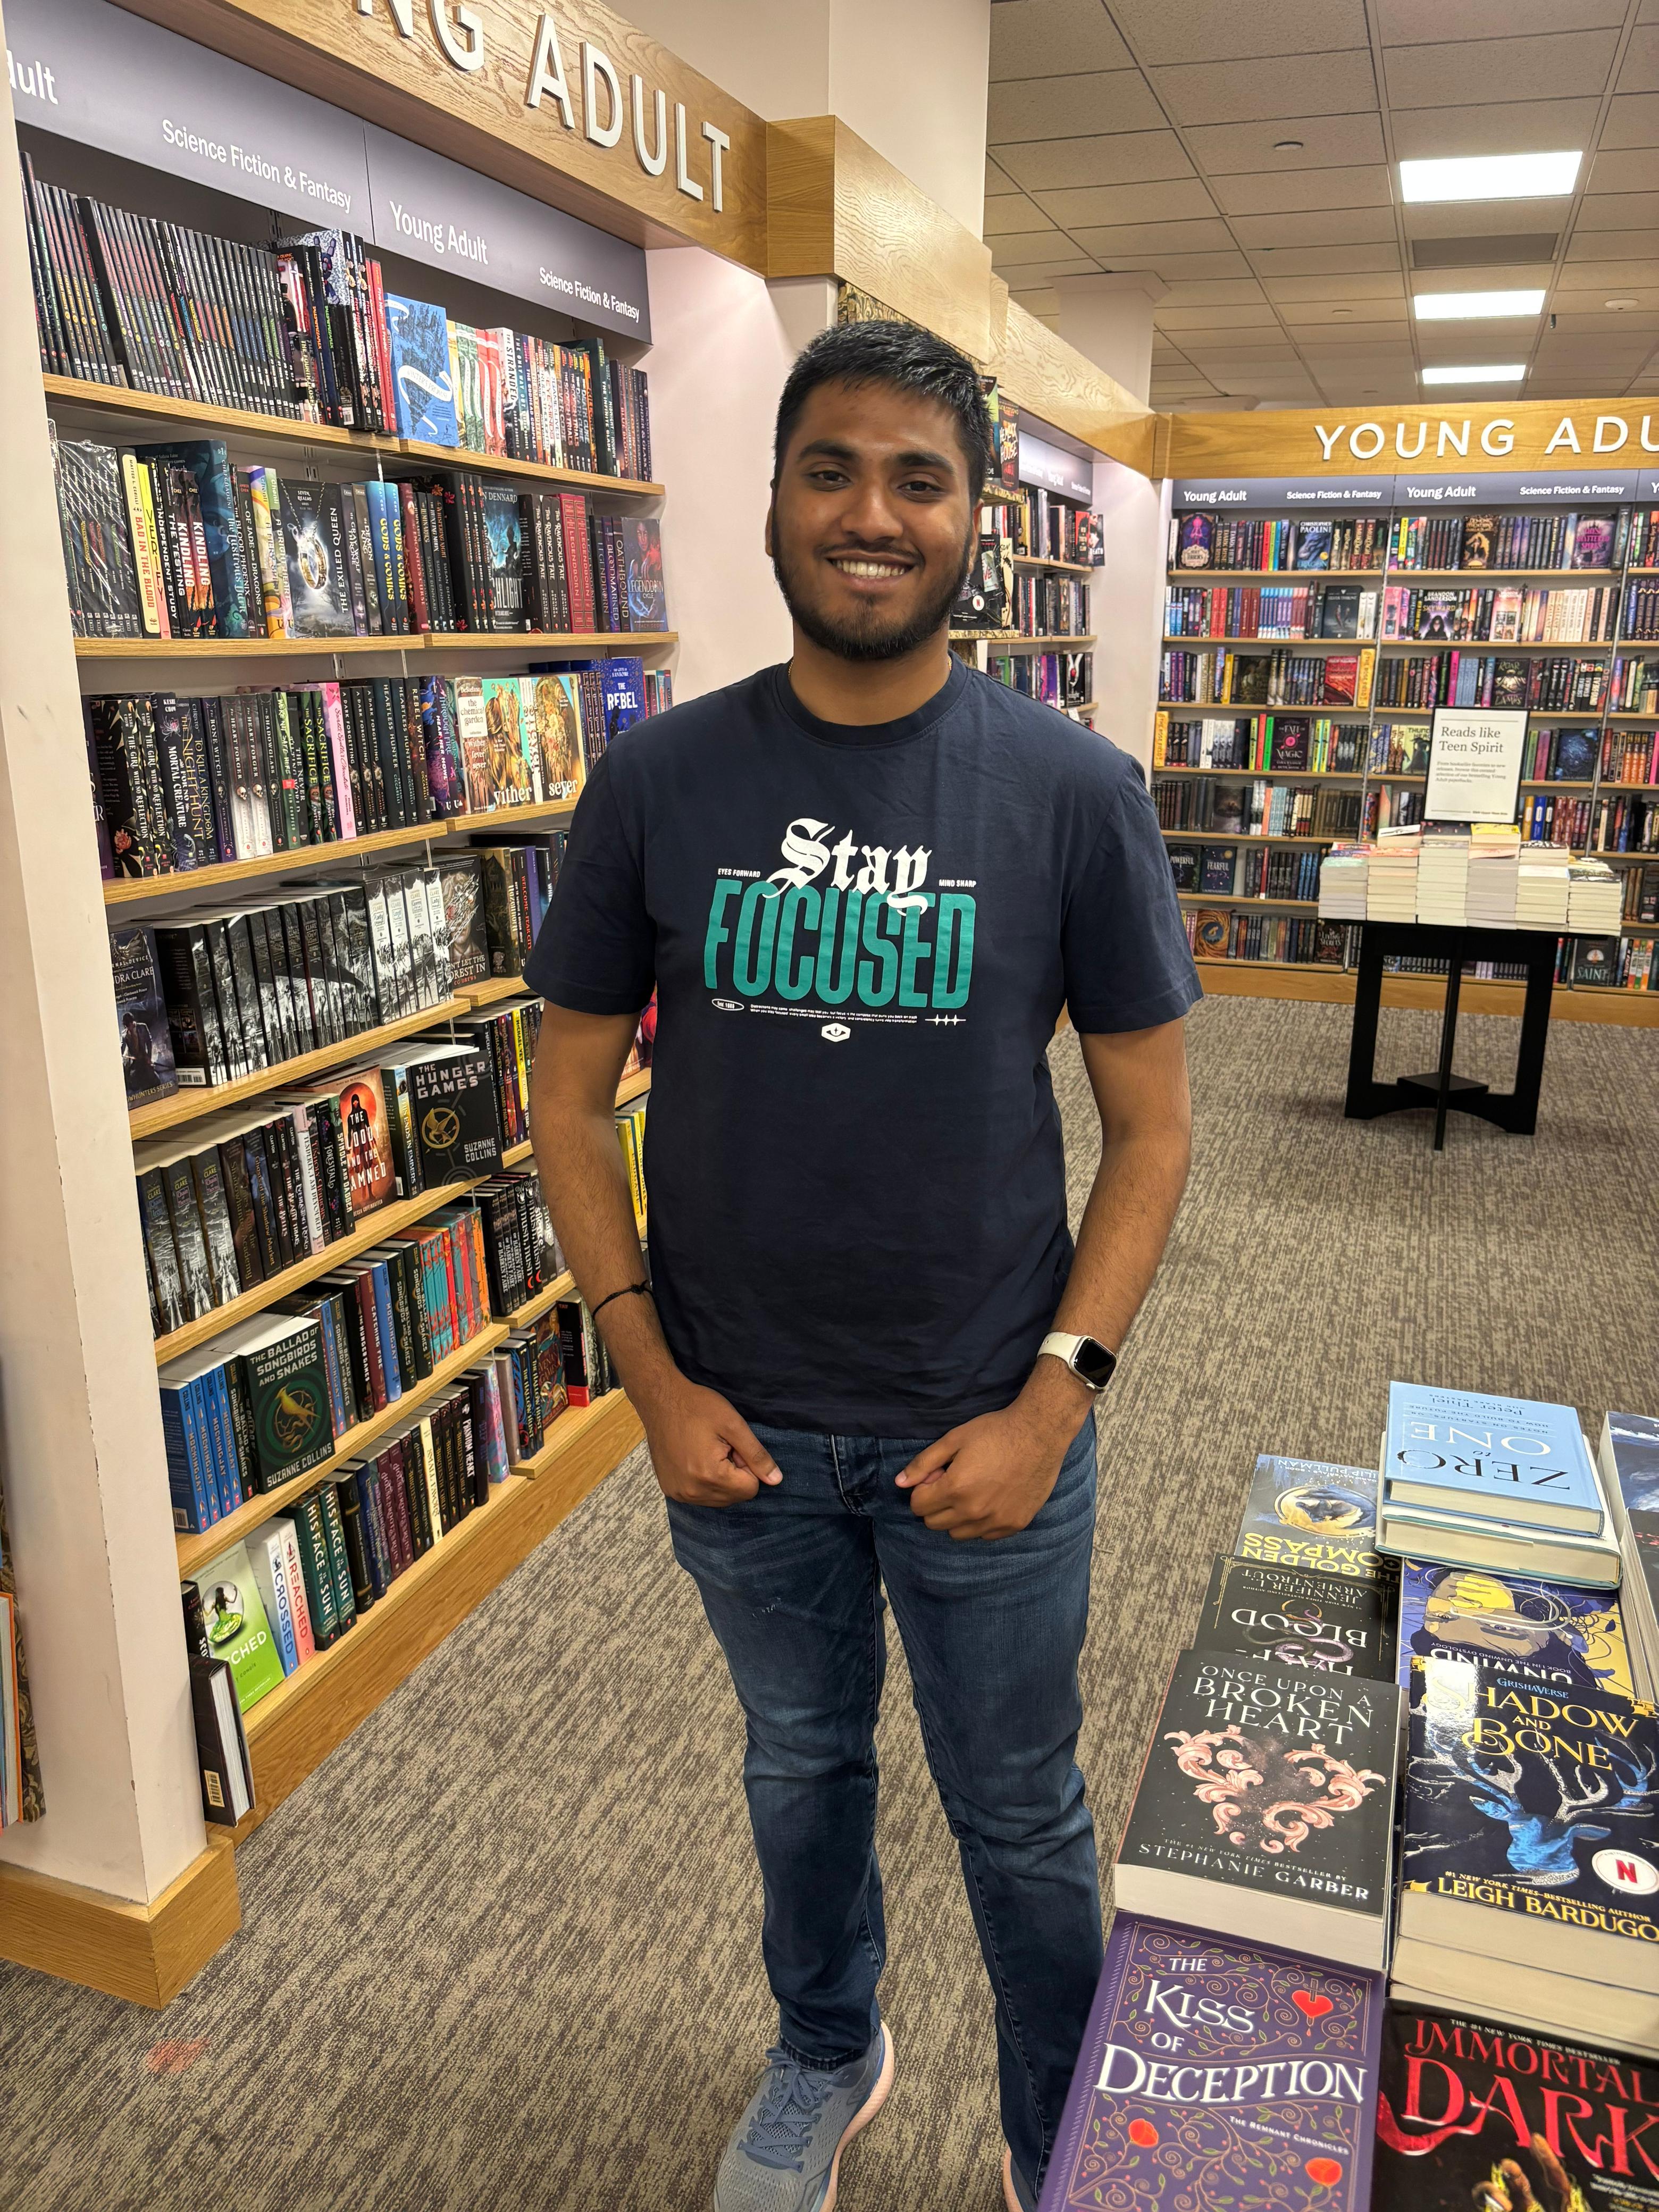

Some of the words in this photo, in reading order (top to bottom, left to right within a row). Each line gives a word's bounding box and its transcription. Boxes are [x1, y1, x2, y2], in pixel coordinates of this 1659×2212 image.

[525, 14, 731, 213] ADULT
[162, 118, 227, 163] Science
[230, 145, 280, 184] Fiction
[284, 166, 297, 190] &
[299, 171, 352, 214] Fantasy
[389, 200, 445, 254] Young
[448, 225, 489, 266] Adult
[539, 266, 574, 297] Science
[575, 280, 602, 307] Fiction
[603, 292, 610, 308] &
[611, 295, 640, 323] Fantasy
[506, 341, 516, 400] STRANDED
[1314, 418, 1515, 460] YOUNG
[489, 493, 518, 504] DENNARD
[1184, 491, 1217, 503] Young
[1219, 490, 1247, 501] Adult
[1286, 491, 1314, 500] Science
[1317, 490, 1342, 499] Fiction
[1344, 490, 1351, 499] &
[1351, 489, 1382, 500] Fantasy
[1406, 487, 1442, 500] Young
[1444, 486, 1476, 498] Adult
[1519, 486, 1552, 496] Science
[1553, 486, 1581, 495] Fiction
[1582, 486, 1590, 495] &
[1591, 484, 1625, 495] Fantasy
[135, 516, 145, 538] BAD
[330, 507, 341, 546] QUEEN
[141, 555, 150, 575] THE
[146, 509, 164, 602] VERIFY
[167, 513, 177, 539] THE
[173, 542, 185, 597] TESTING
[177, 522, 195, 587] KINDLING
[193, 521, 211, 586] KINDLING
[336, 549, 345, 588] EXILED
[144, 577, 155, 608] BLOOD
[616, 540, 629, 618] OATHBOUND
[167, 585, 177, 619] STUDY
[460, 707, 485, 716] chemical
[607, 692, 638, 711] REBEL
[383, 684, 393, 731] HEARTLESS
[390, 734, 398, 768] HUNTER
[412, 689, 421, 720] REBEL
[417, 725, 425, 761] WITCH
[464, 715, 484, 725] garden
[1440, 726, 1476, 738] Reads
[1479, 727, 1501, 739] like
[305, 719, 317, 784] SACRIFICE
[1439, 741, 1468, 751] Teen
[1471, 742, 1504, 755] Spirit
[549, 778, 578, 796] sever
[718, 868, 732, 876] EYES
[733, 869, 761, 878] FORWARD
[762, 818, 932, 917] Stay
[1207, 860, 1229, 871] FEARFUL
[939, 879, 956, 887] MIND
[957, 879, 977, 888] SHARP
[704, 878, 977, 1009] FOCUSED
[1577, 967, 1607, 981] SAINT
[415, 1060, 486, 1087] HUNGER
[418, 1063, 436, 1073] THE
[417, 1075, 480, 1100] GAMES
[350, 1111, 364, 1126] THE
[346, 1123, 380, 1151] LOODY
[464, 1137, 495, 1153] SUZANNE
[364, 1150, 378, 1162] THE
[465, 1147, 497, 1163] COLLINS
[337, 1133, 346, 1166] SPINDLE
[344, 1180, 353, 1213] DAGGER
[350, 1161, 387, 1191] AMNED
[250, 1352, 266, 1364] THE
[267, 1331, 309, 1358] BALLAD
[309, 1326, 319, 1338] OF
[256, 1339, 317, 1377] SONGBIRDS
[259, 1373, 275, 1387] AND
[276, 1352, 318, 1380] SNAKES
[1409, 1405, 1447, 1413] FUTURE
[1433, 1398, 1473, 1409] Thiel
[1481, 1404, 1522, 1416] Peter
[1410, 1421, 1552, 1455] ONE
[1513, 1426, 1548, 1434] NOTES
[189, 1432, 202, 1493] MOCKINGJAY
[267, 1460, 301, 1487] SUZANNE
[301, 1442, 332, 1469] COLLINS
[1278, 1459, 1350, 1476] PULLMAN
[1396, 1449, 1570, 1490] ZERO
[307, 1504, 319, 1531] HIS
[311, 1534, 325, 1572] FACE
[1242, 1546, 1361, 1577] GOLDEN
[1244, 1532, 1401, 1573] COMPASS
[1242, 1569, 1368, 1598] ARMENTROUT
[1273, 1581, 1360, 1604] JENNIFER
[1365, 1569, 1401, 1583] THE
[273, 1571, 294, 1655] CROSSED
[289, 1563, 308, 1639] REACHED
[320, 1583, 333, 1616] SUN
[1230, 1607, 1368, 1649] BLOOD
[1431, 1641, 1477, 1655] DYSTOLOGY
[1479, 1652, 1513, 1663] UNWIND
[1201, 1665, 1267, 1687] ONCE
[1277, 1679, 1344, 1700] UPON
[1358, 1695, 1371, 1706] A
[1546, 1666, 1571, 1674] BOOK
[1192, 1677, 1375, 1728] BROKEN
[1423, 1675, 1639, 1738] SHADOW
[1204, 1698, 1353, 1745] HEART
[1512, 1715, 1552, 1731] AND
[1461, 1717, 1613, 1771] BONE
[1138, 1842, 1264, 1878] STEPHANIE
[1275, 1870, 1370, 1900] GARBER
[1164, 1838, 1182, 1847] THE
[1197, 1845, 1216, 1854] NEW
[1219, 1849, 1241, 1859] YORK
[1245, 1855, 1271, 1865] TIMES
[1274, 1862, 1333, 1879] BESTSELLER
[1438, 1876, 1515, 1908] LEIGH
[1526, 1895, 1659, 1943] BARDUGO
[1459, 1873, 1481, 1882] NEW
[1483, 1879, 1509, 1889] YORK
[1608, 1908, 1652, 1923] AUTHOR
[1169, 1957, 1208, 1972] THE
[1143, 1979, 1255, 2033] KISS
[1151, 2031, 1185, 2052] OF
[1450, 2018, 1468, 2028] THE
[1484, 2026, 1505, 2037] NEW
[1507, 2031, 1534, 2044] YORK
[1536, 2038, 1563, 2051] TIMES
[1564, 2044, 1621, 2066] BESTSELLER
[1093, 2042, 1368, 2104] DECEPTION
[1404, 2018, 1659, 2108] IMMORTAL
[1376, 2052, 1659, 2182] DARK
[1229, 2115, 1246, 2126] THE
[1249, 2120, 1291, 2140] REMNANT
[1293, 2132, 1350, 2156] CHRONICLES
